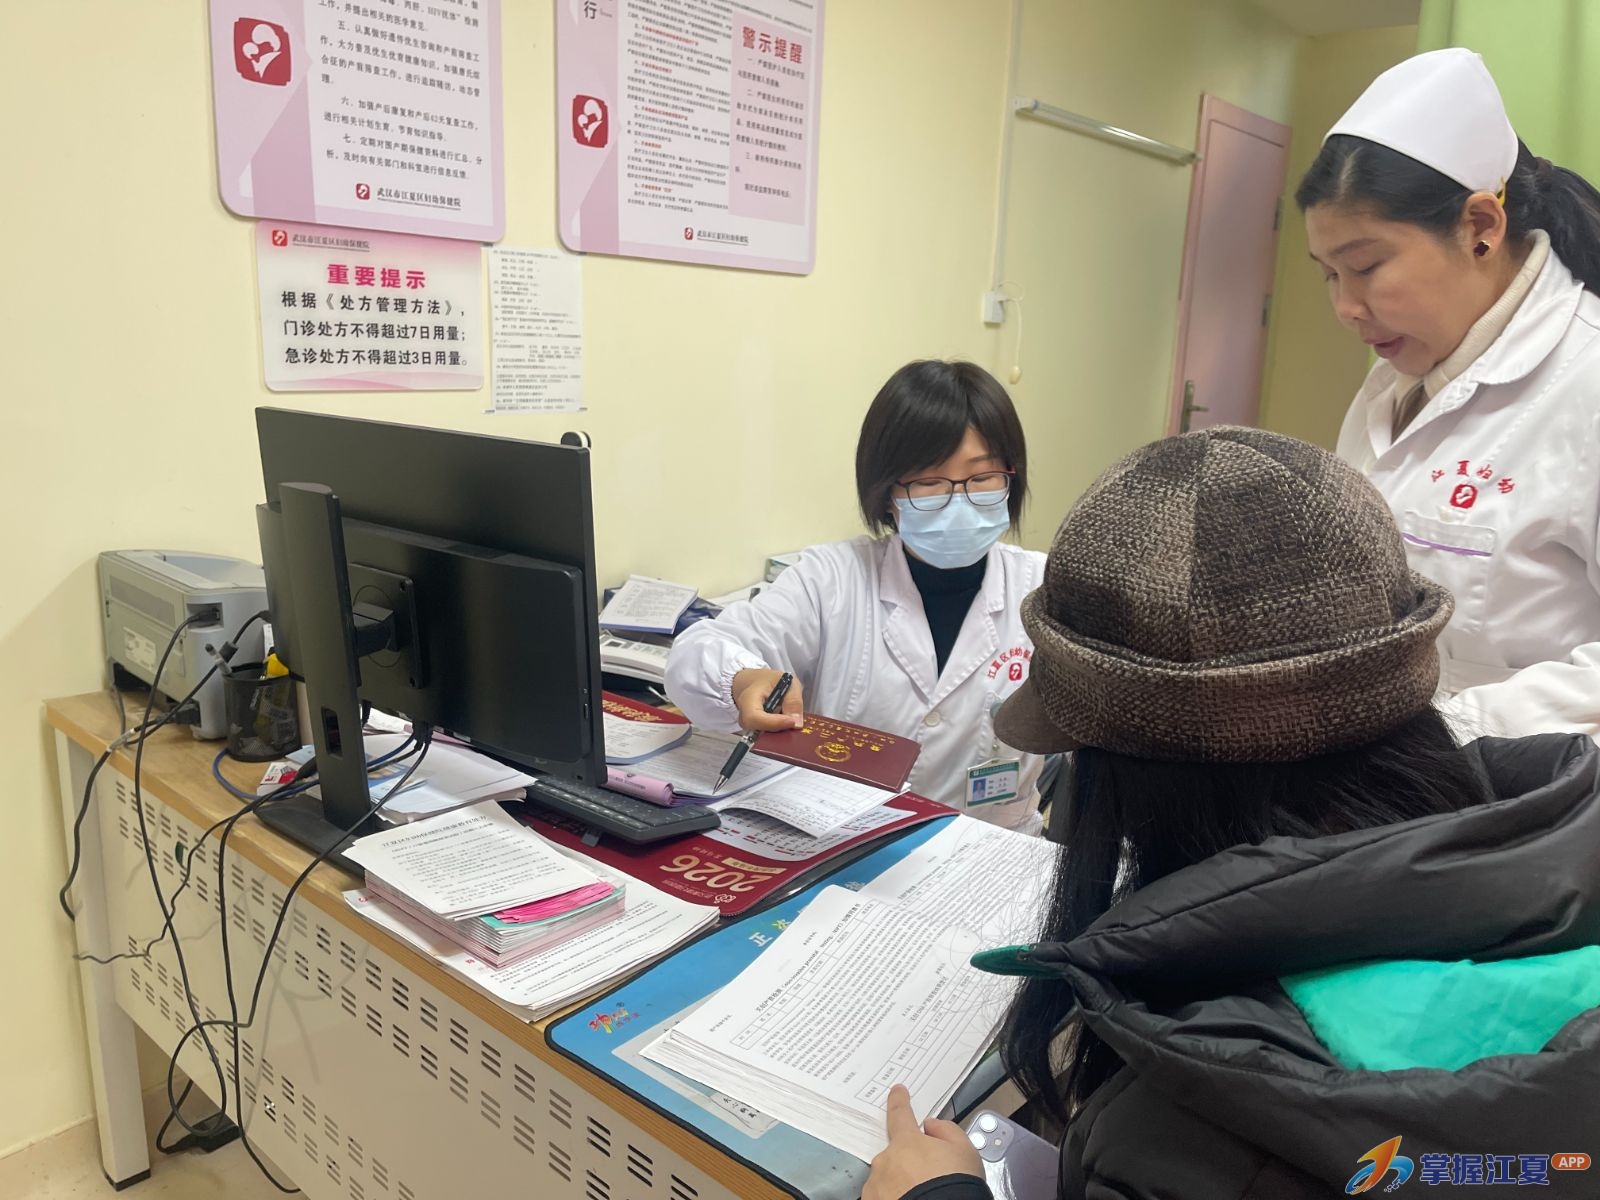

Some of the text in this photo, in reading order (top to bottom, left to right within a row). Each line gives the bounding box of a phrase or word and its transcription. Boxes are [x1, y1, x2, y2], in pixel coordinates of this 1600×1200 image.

[742, 26, 803, 64] 警示提醒
[376, 187, 462, 207] 武汉市江夏区妇幼保健院
[327, 263, 426, 290] 重要提示
[281, 291, 465, 317] 根据《处方管理方法》，
[283, 319, 466, 341] 门诊处方不得超过7日用量；
[285, 347, 468, 367] 急诊处方不得超过3日用量。
[660, 853, 773, 893] 2026
